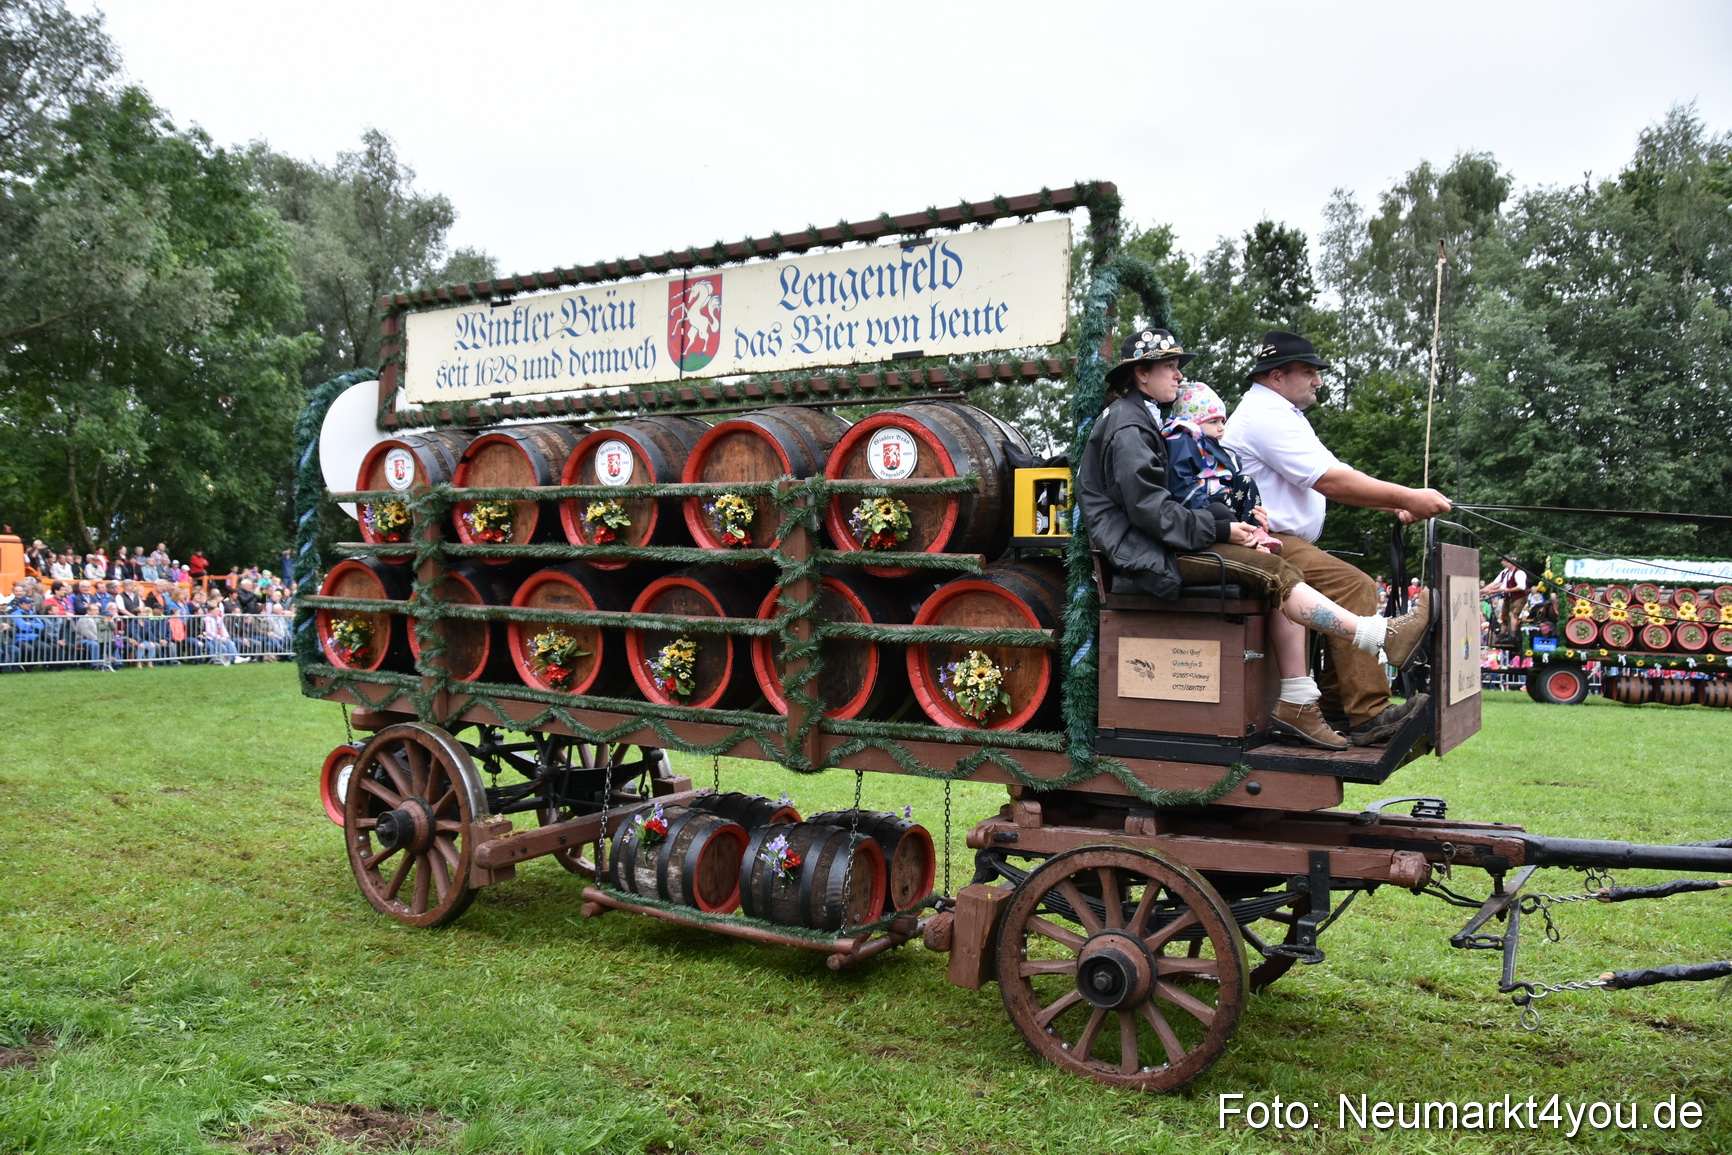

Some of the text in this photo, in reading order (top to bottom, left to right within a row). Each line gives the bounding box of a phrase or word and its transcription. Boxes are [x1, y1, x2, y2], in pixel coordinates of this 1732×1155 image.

[777, 239, 964, 312] Lengenfeld
[453, 289, 636, 351] Winkler Bräu
[734, 297, 1009, 360] das Bier von heute
[435, 334, 658, 390] seit 1628 und dennoch
